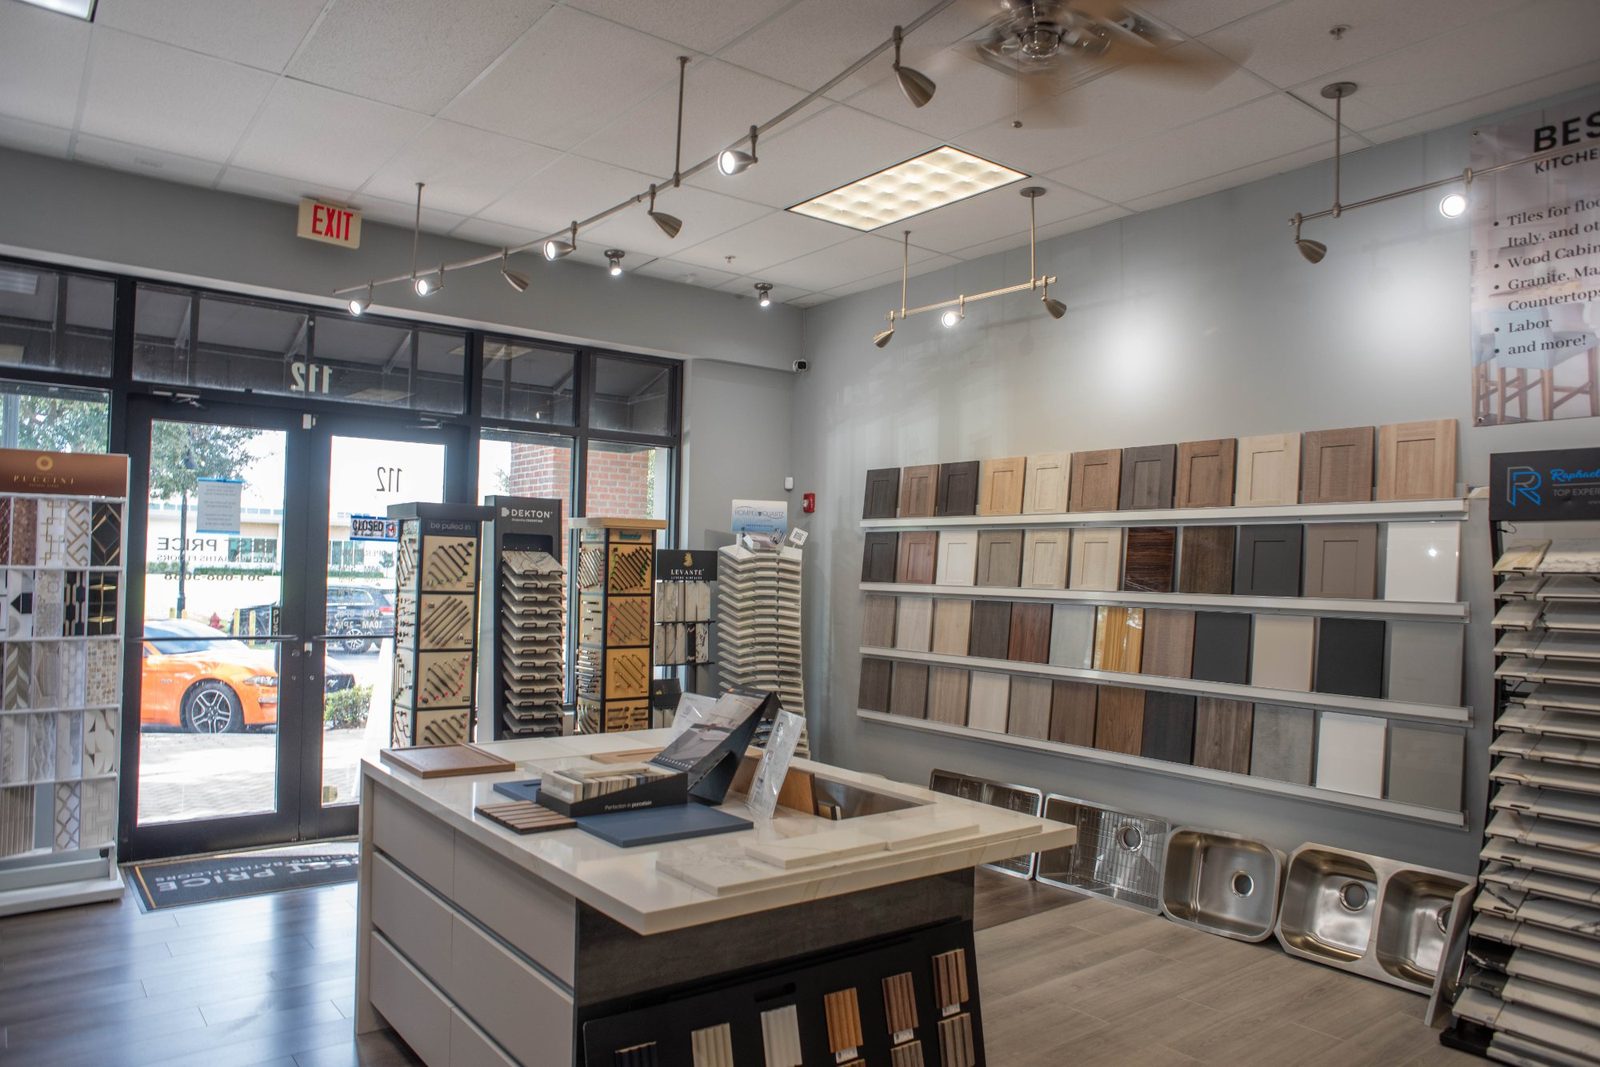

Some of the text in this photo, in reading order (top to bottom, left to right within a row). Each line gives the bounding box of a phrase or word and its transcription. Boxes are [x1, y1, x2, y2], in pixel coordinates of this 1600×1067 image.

[1533, 111, 1600, 153] BES
[1534, 148, 1600, 174] KITCHE
[311, 204, 353, 241] EXIT
[1507, 211, 1544, 226] Tiles
[1548, 206, 1571, 218] for
[1548, 223, 1579, 240] and
[1507, 250, 1550, 268] Wood
[1508, 319, 1552, 333] Labor
[1508, 334, 1586, 355] and more!
[511, 508, 550, 519] DEKTON
[352, 519, 384, 532] CLOSED
[430, 521, 440, 529] be
[441, 522, 463, 530] pulled
[670, 568, 703, 576] LEVANTE
[156, 857, 358, 892] EST PRICE
